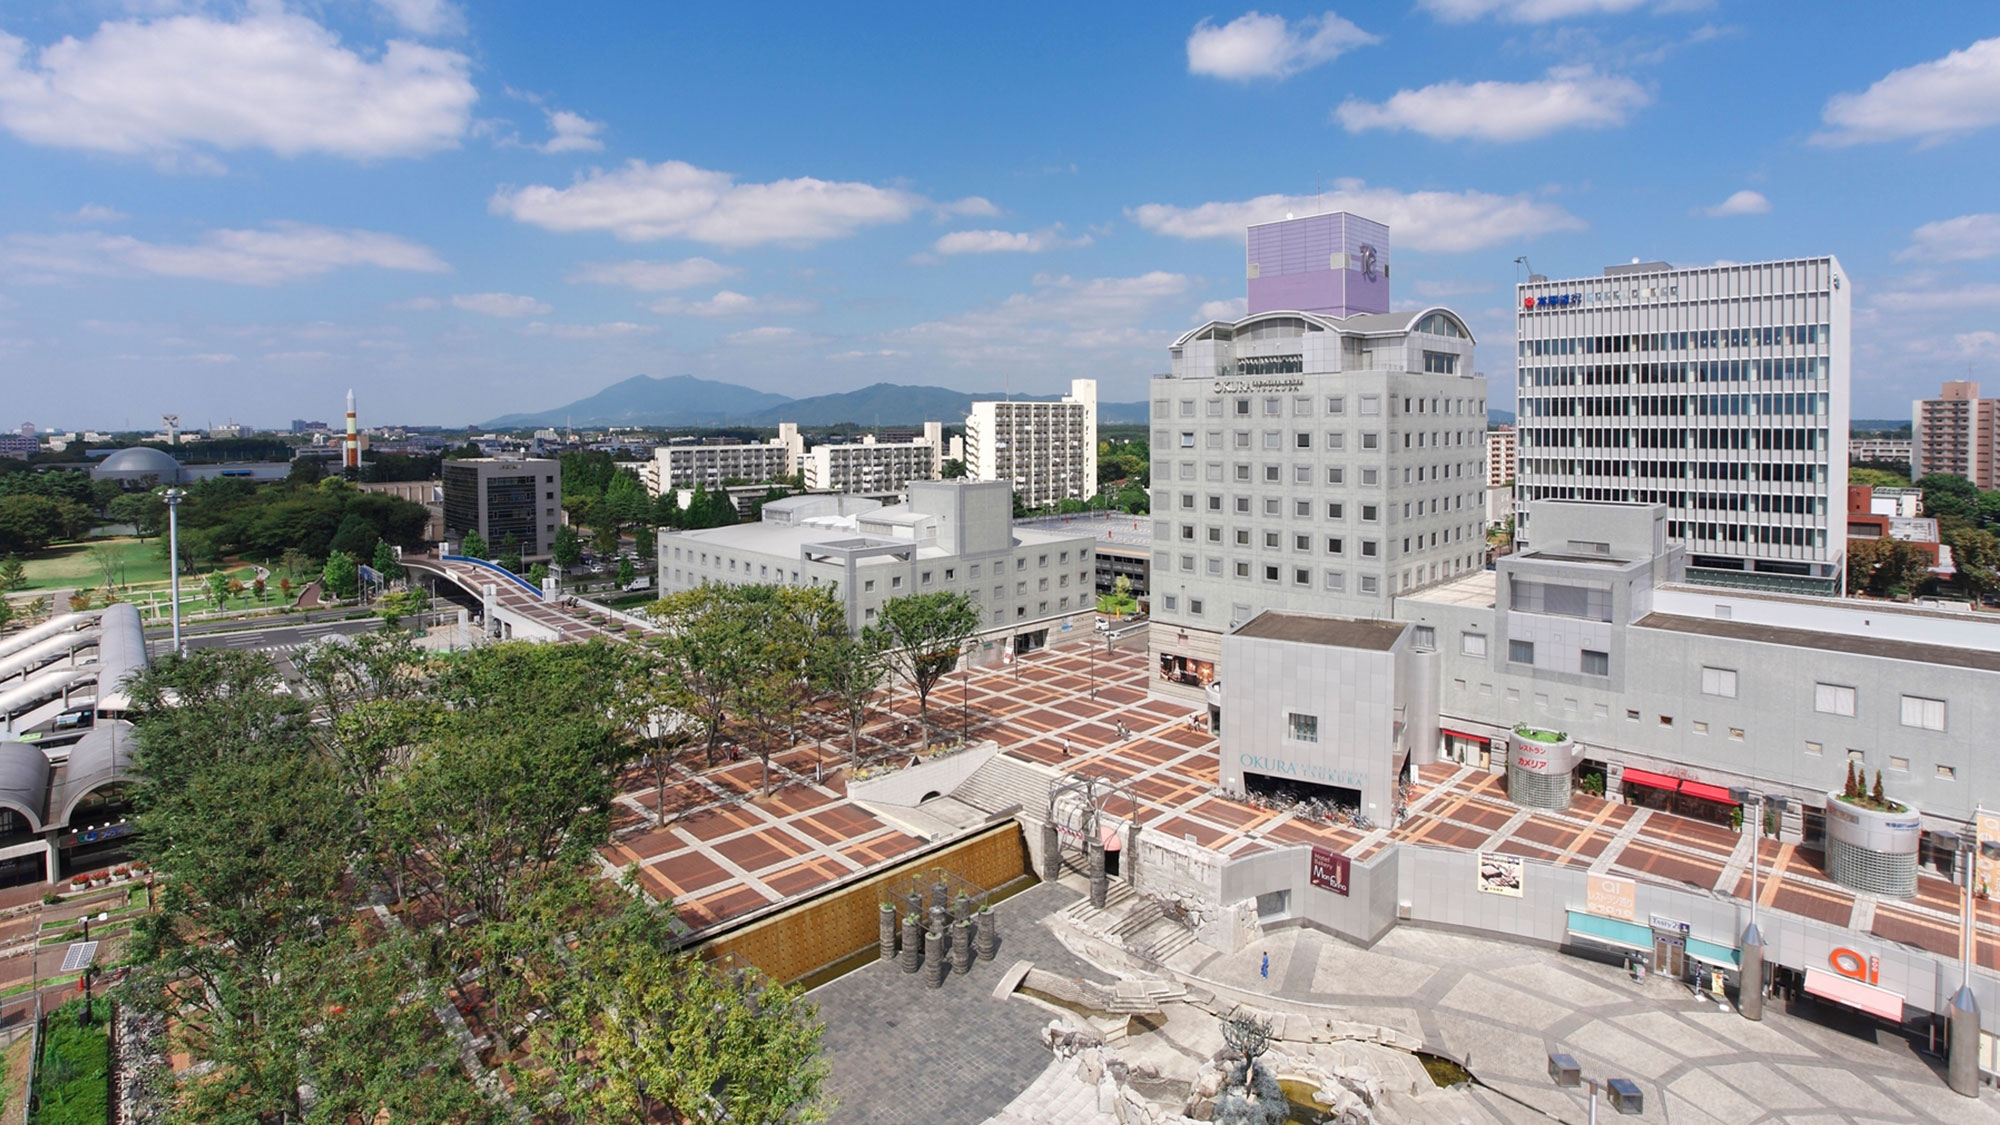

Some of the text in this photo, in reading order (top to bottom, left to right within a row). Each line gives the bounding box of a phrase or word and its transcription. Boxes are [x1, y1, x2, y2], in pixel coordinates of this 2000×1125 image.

[1214, 381, 1254, 394] OKURA
[1519, 744, 1546, 755] レストラン
[1240, 753, 1297, 776] OKURA
[1518, 757, 1547, 769] カメリア
[1302, 770, 1362, 787] TSUKUBA
